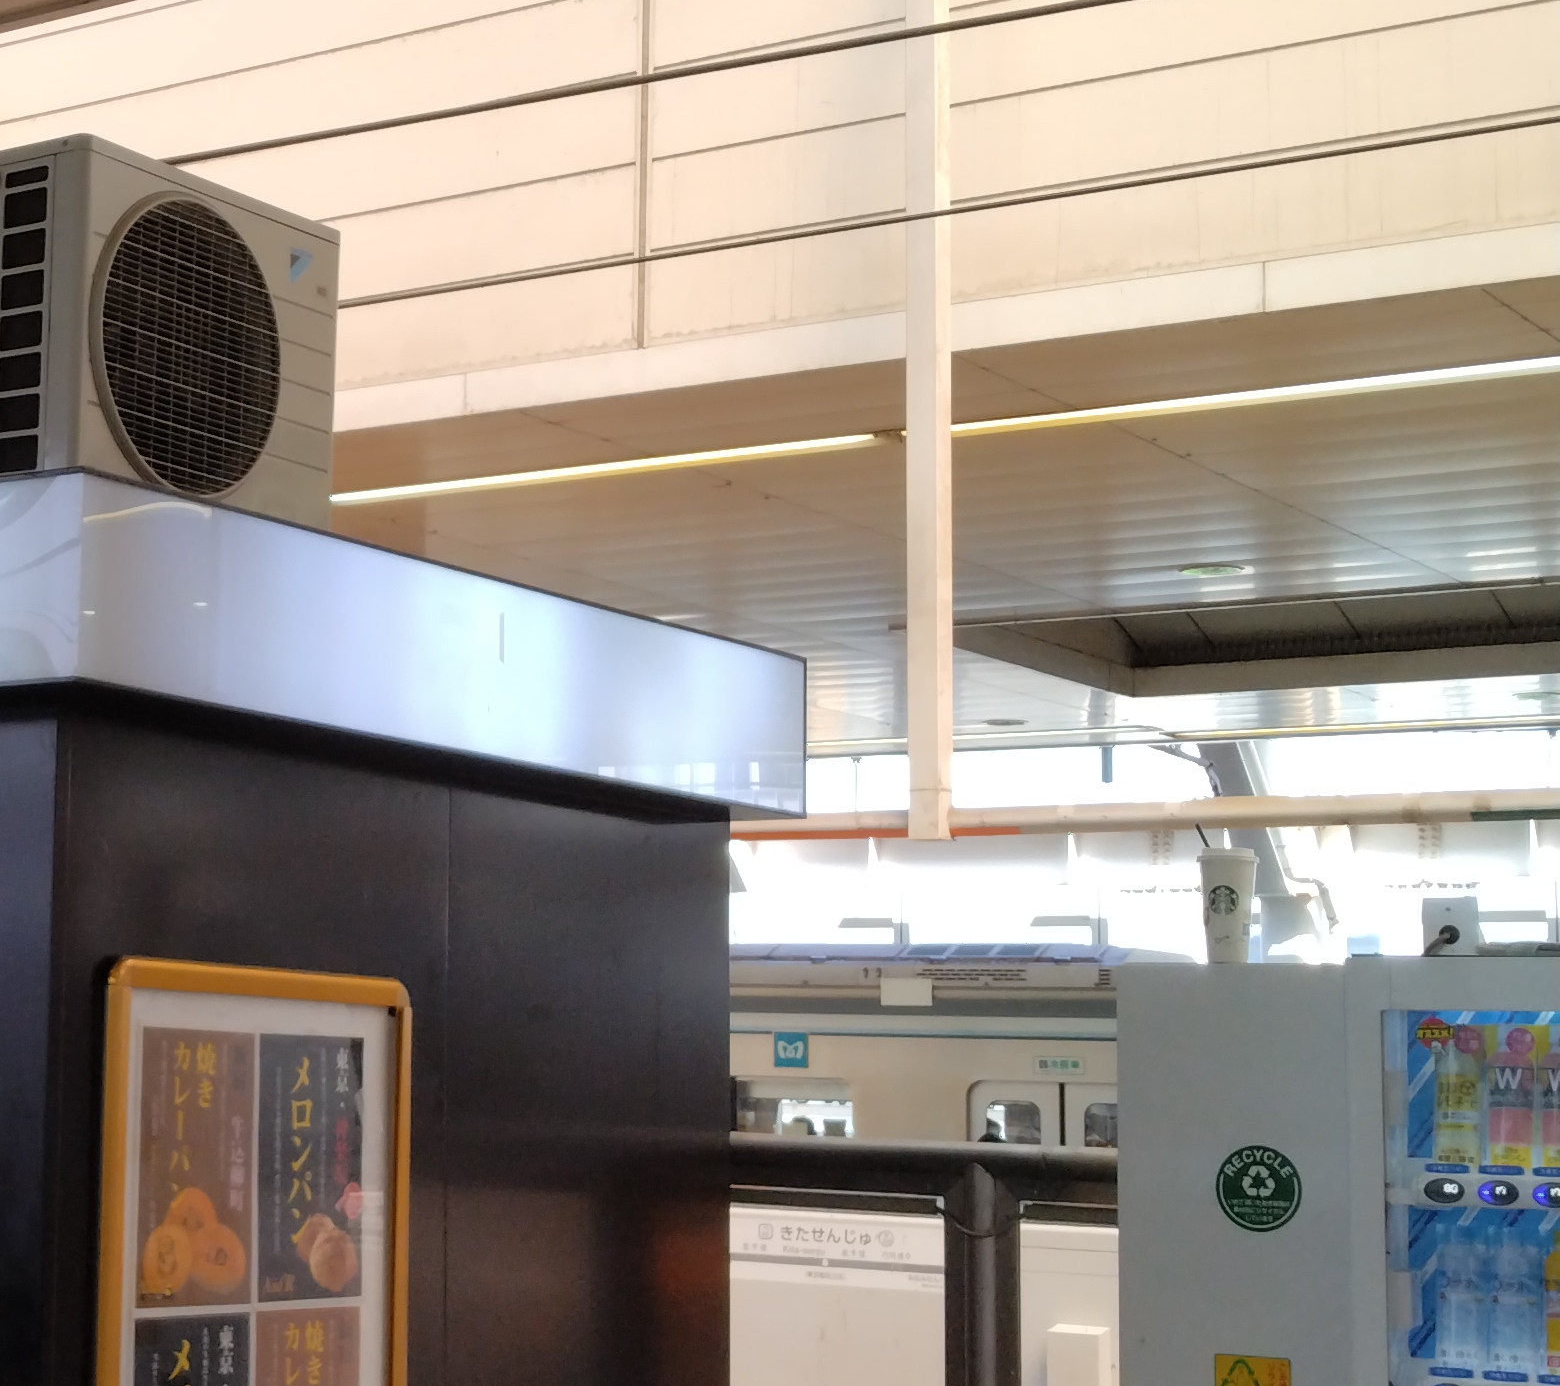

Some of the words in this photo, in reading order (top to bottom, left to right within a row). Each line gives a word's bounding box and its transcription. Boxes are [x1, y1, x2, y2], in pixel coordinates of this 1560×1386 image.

[1223, 1149, 1294, 1179] RECYCLE
[780, 1225, 872, 1245] きたせんじゅ
